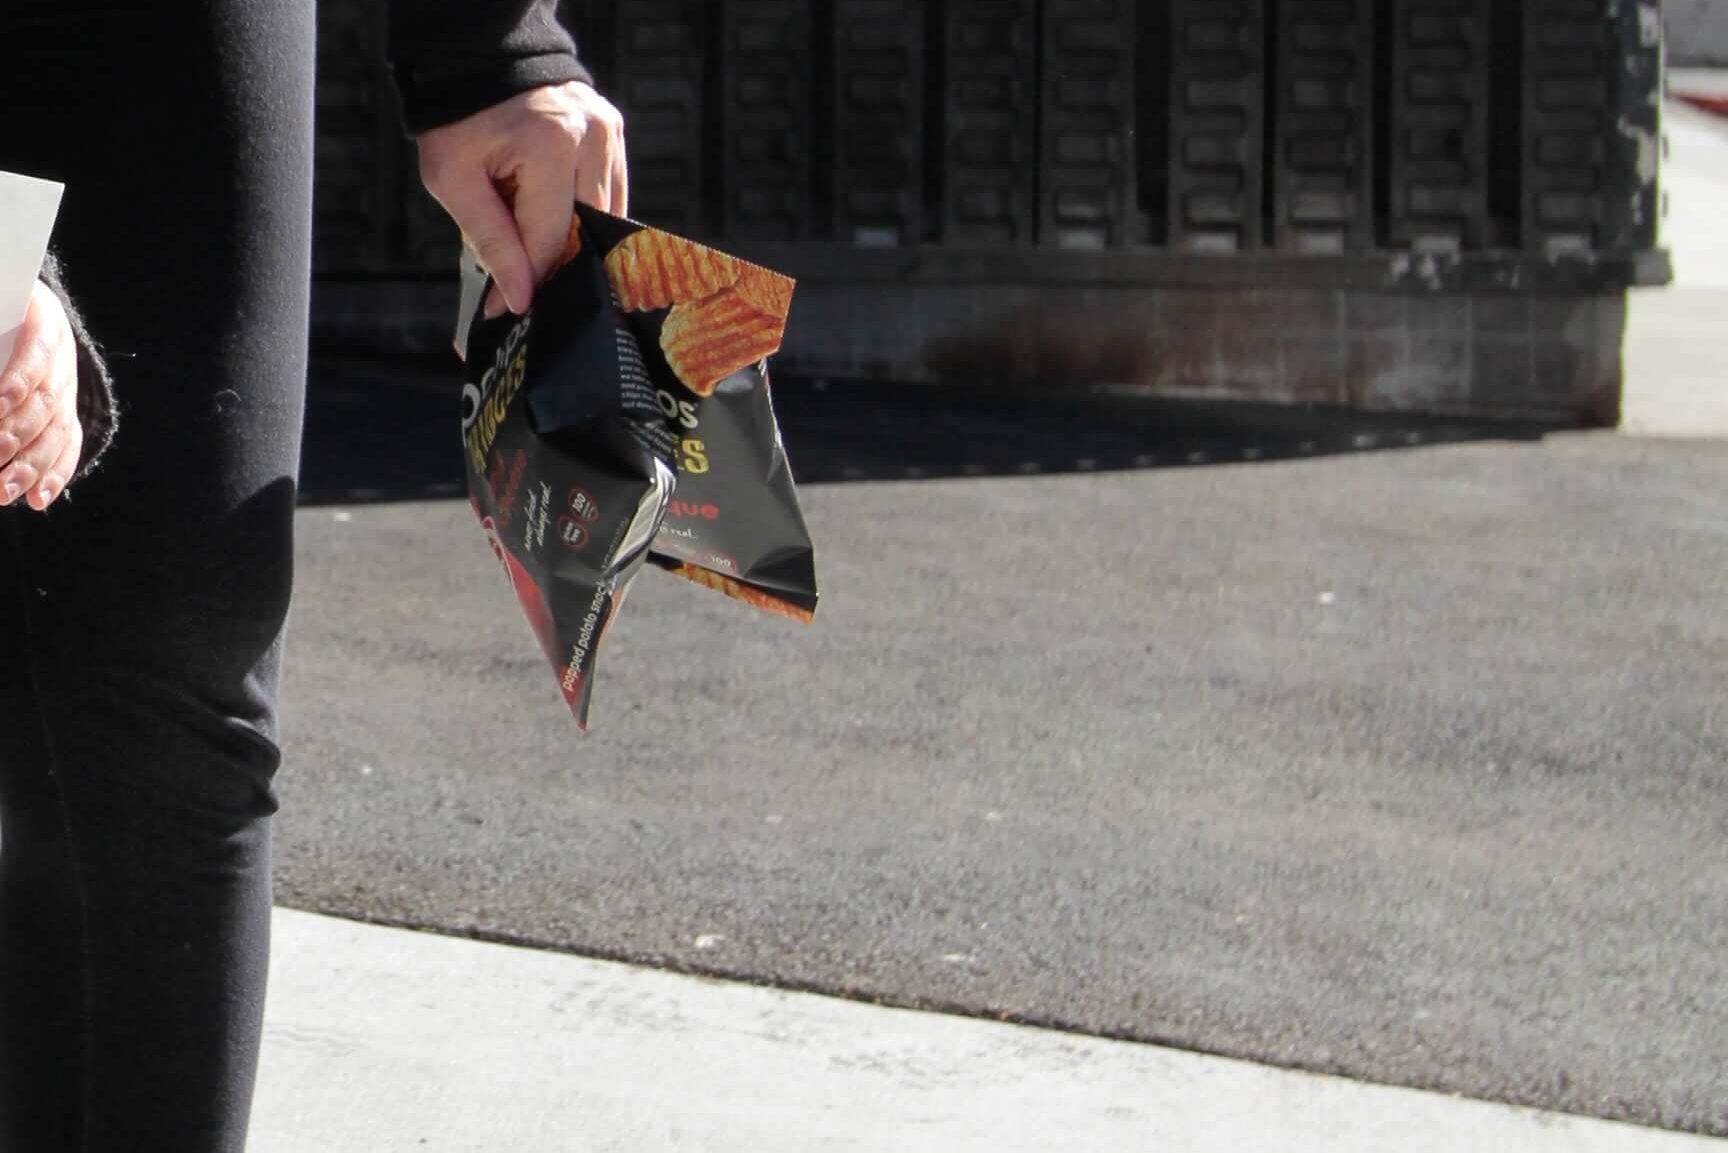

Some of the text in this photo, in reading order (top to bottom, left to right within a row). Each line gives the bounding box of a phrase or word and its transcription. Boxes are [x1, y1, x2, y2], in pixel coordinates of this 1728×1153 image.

[572, 492, 586, 513] 100
[562, 646, 585, 692] popped
[578, 612, 598, 650] potato
